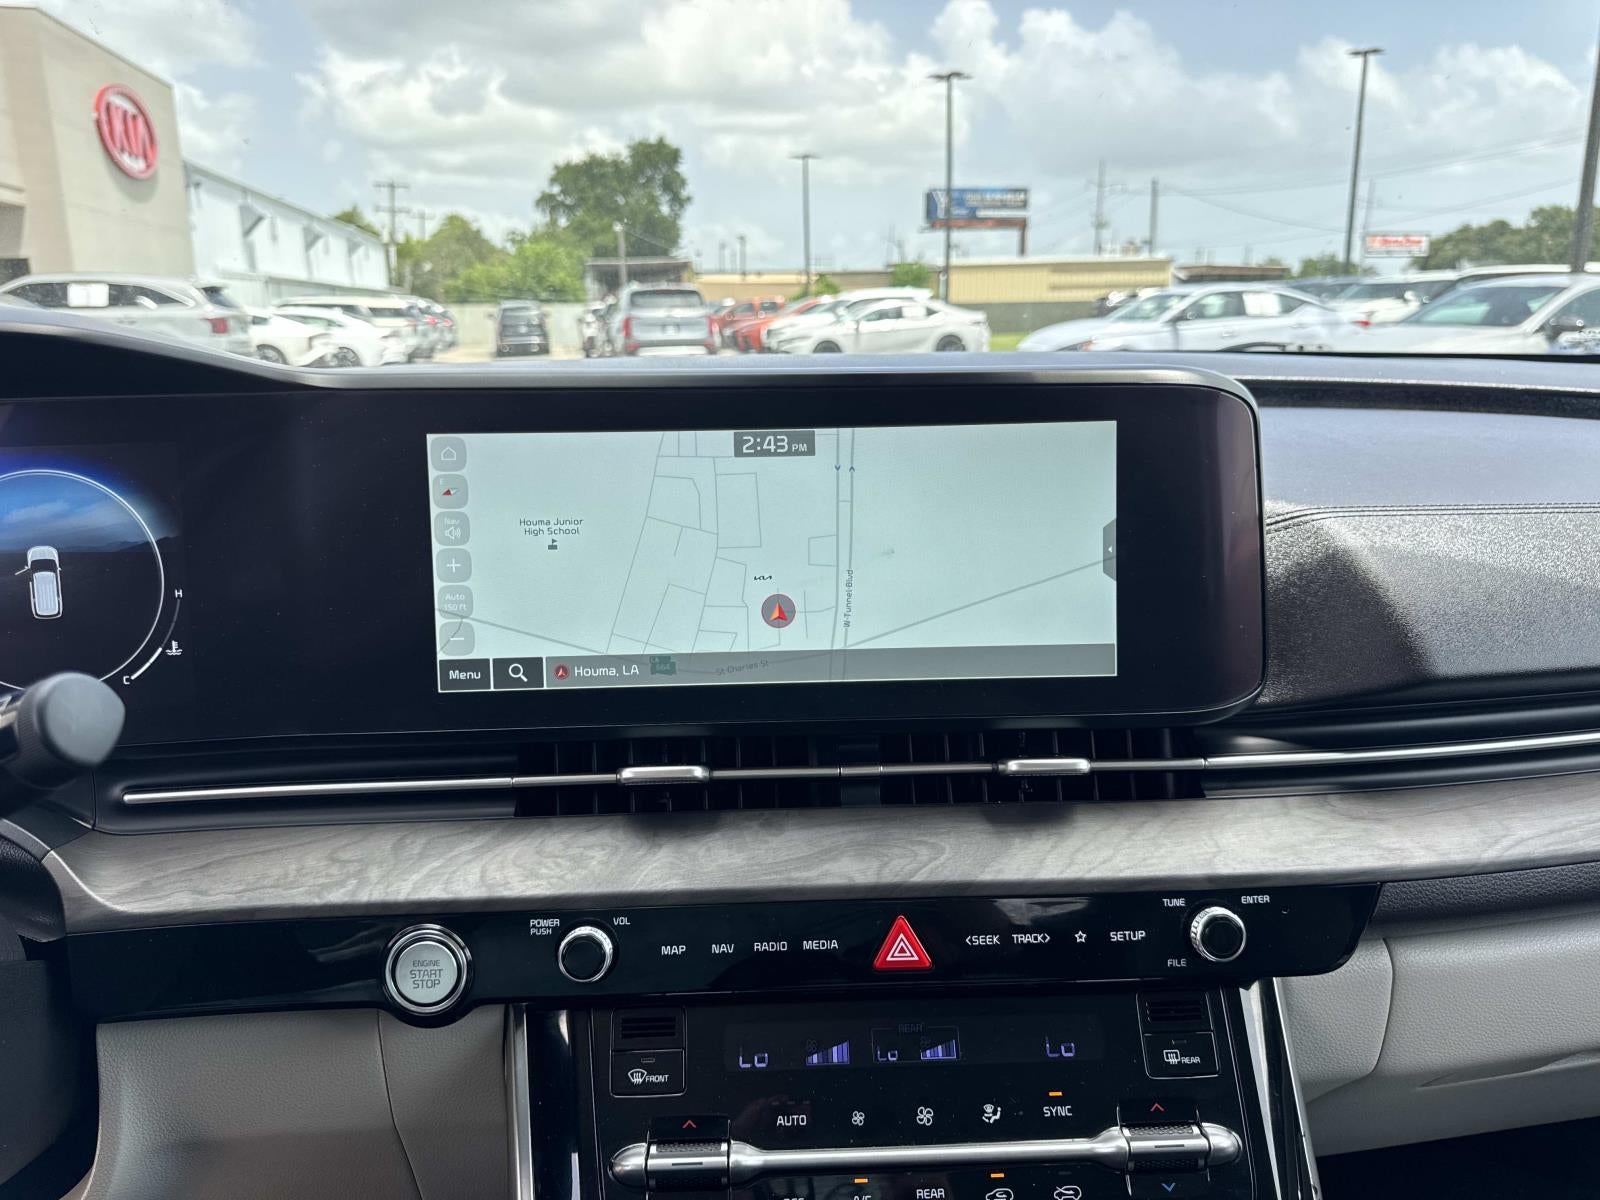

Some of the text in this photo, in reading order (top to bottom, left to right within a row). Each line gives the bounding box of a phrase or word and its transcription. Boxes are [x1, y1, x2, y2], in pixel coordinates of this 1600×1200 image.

[742, 435, 808, 453] 2:43 PM
[519, 517, 585, 527] Houma Junior
[524, 527, 580, 537] High School
[845, 569, 854, 588] Blvd
[175, 589, 183, 598] H
[445, 593, 465, 601] Auto
[843, 590, 853, 617] Tunnel
[448, 669, 481, 681] Menu
[574, 665, 639, 679] Houma, LA
[123, 676, 131, 685] C
[1163, 898, 1186, 908] TUNE
[1241, 894, 1270, 905] ENTER
[529, 918, 560, 928] POWER
[613, 917, 631, 926] VOL
[530, 927, 553, 935] PUSH
[1109, 930, 1146, 942] SETUP
[661, 945, 686, 956] MAP
[711, 944, 734, 955] NAV
[753, 942, 788, 953] RADIO
[802, 940, 839, 951] MEDIA
[412, 959, 441, 968] ENGINE
[1167, 958, 1187, 968] FILE
[409, 968, 443, 979] START
[412, 979, 441, 989] STOP
[1181, 1054, 1200, 1064] REAR
[645, 1073, 669, 1083] FRONT
[1043, 1105, 1072, 1117] SYNC
[776, 1114, 807, 1126] AUTO
[916, 1188, 945, 1200] REAR
